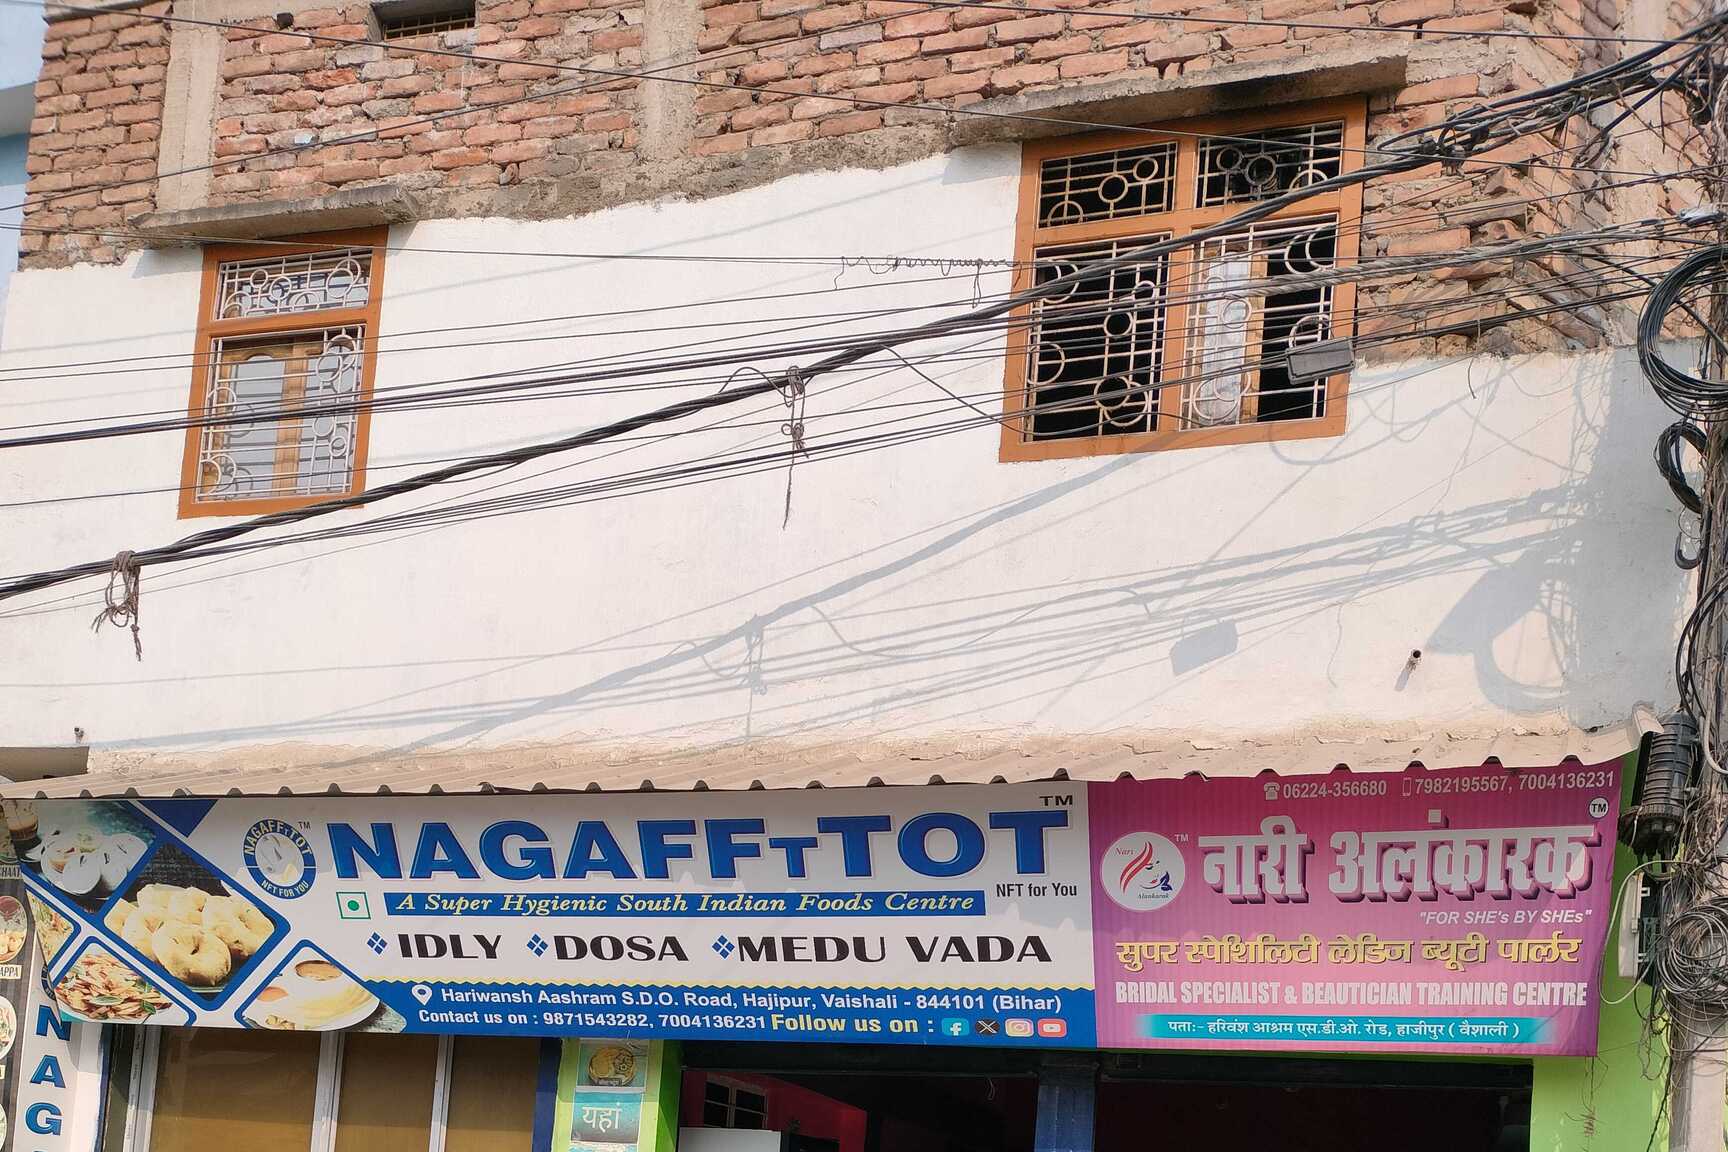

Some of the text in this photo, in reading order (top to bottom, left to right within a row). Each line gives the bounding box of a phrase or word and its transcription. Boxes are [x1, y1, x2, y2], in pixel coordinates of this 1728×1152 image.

[1283, 780, 1387, 799] 06224-356680
[1414, 771, 1615, 796] 7982195567, 7004136231
[1040, 795, 1074, 806] TM
[1591, 802, 1607, 813] TM
[1198, 809, 1600, 900] नारी अलंकारक
[996, 882, 1078, 898] NFT for You
[396, 892, 975, 917] A Super Hygienic South Indian Foods Centre
[1513, 910, 1538, 924] BY
[397, 933, 1053, 963] IDLY DOSA MEDU VADA
[1115, 940, 1181, 973] सुपर
[1421, 931, 1490, 972] ब्यूटी
[1497, 930, 1583, 963] पार्लर
[441, 988, 534, 1004] Hariwansh
[537, 989, 617, 1006] Aashram
[621, 991, 679, 1007] S.D.O.
[684, 992, 738, 1009] Road,
[743, 992, 817, 1011] Hajipur,
[821, 992, 898, 1009] Vaishali
[916, 994, 985, 1010] 844101
[992, 994, 1062, 1013] (Bihar)
[1115, 981, 1588, 1006] BRIDAL SPECIALIST & BEAUTICIAN TRAINING CENTRE
[419, 1009, 480, 1024] Contact
[485, 1012, 503, 1025] us
[508, 1013, 528, 1025] on
[543, 1012, 654, 1028] 9871543282,
[658, 1014, 766, 1029] 7004136231
[771, 1014, 846, 1032] Follow
[854, 1018, 882, 1033] us
[890, 1018, 919, 1033] on
[1207, 1018, 1249, 1034] हरिवंश
[1252, 1021, 1293, 1034] आश्रम
[1396, 1019, 1445, 1040] हाजीपुर
[1458, 1018, 1509, 1037] वैशाली
[581, 1101, 623, 1134] यहां
